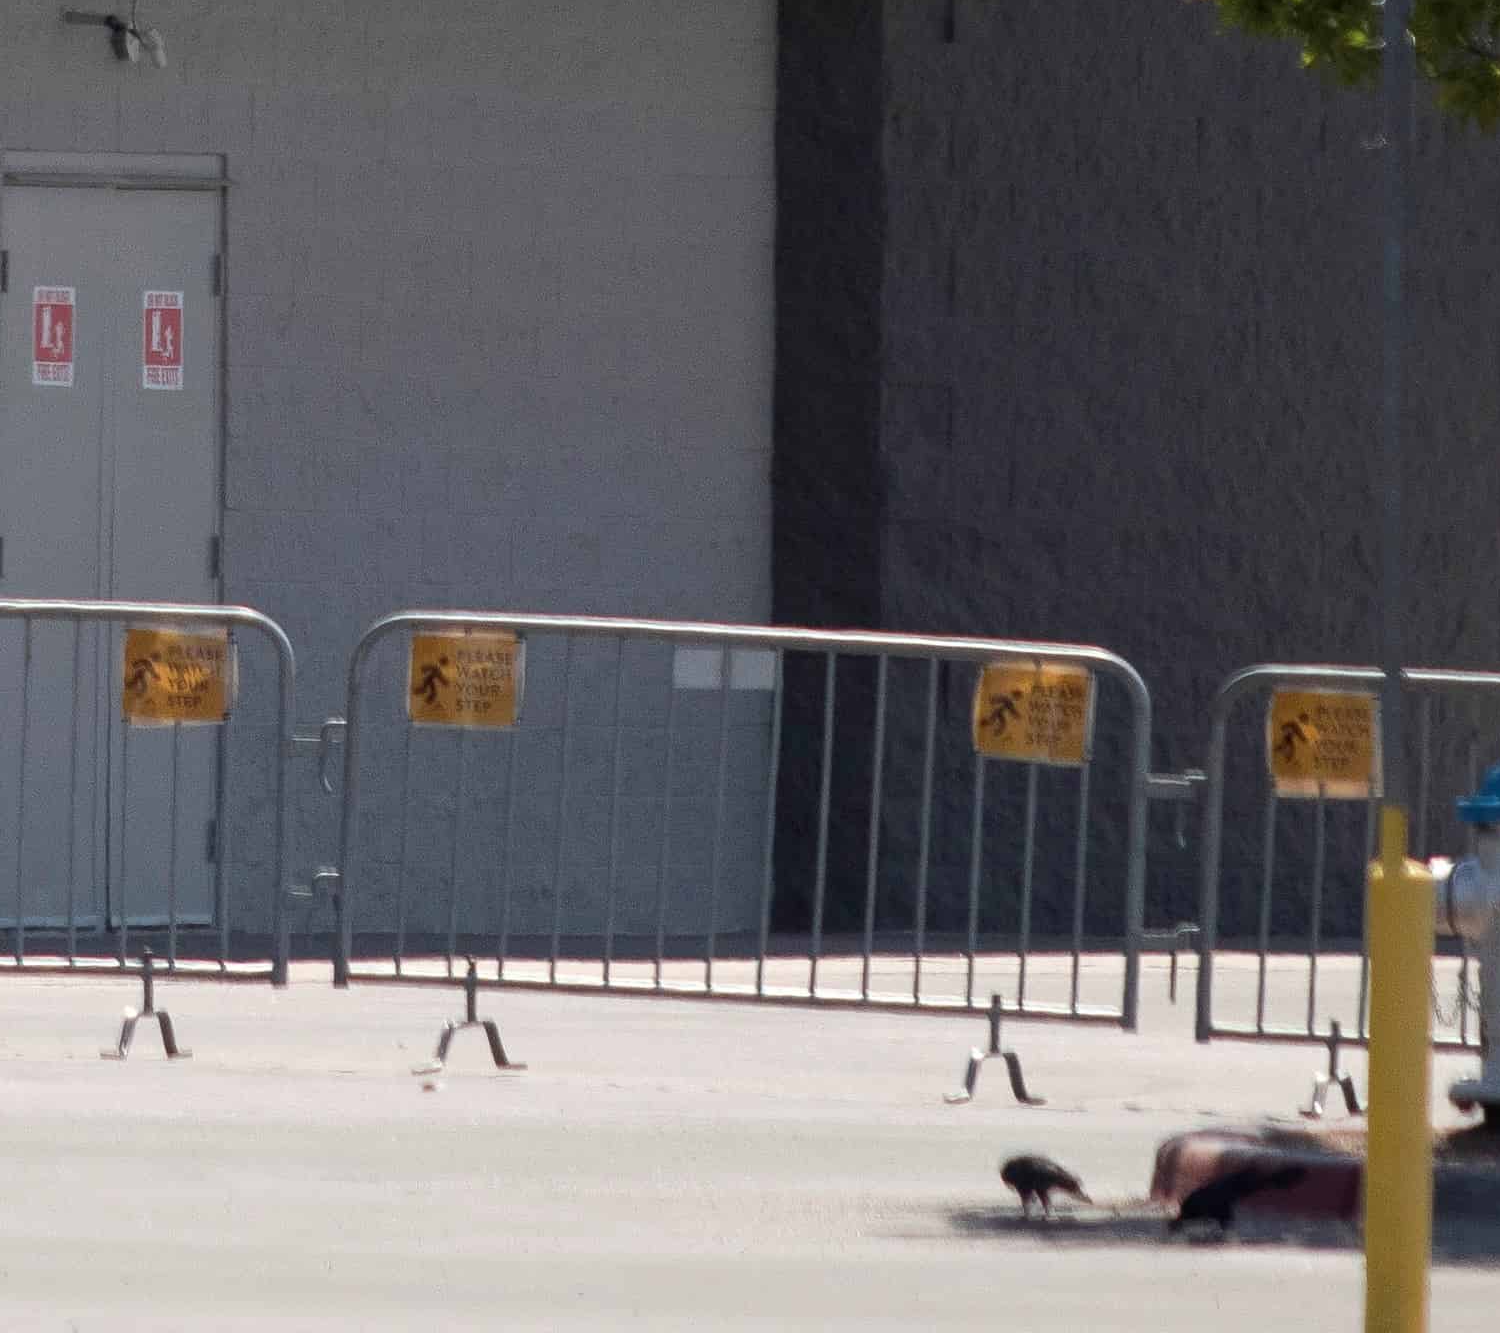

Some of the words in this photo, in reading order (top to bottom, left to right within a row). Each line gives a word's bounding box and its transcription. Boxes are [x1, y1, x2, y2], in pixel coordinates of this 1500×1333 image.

[457, 649, 513, 666] PLEASE
[456, 665, 512, 681] WATCH
[456, 682, 501, 698] YOUR
[456, 698, 492, 714] STEP
